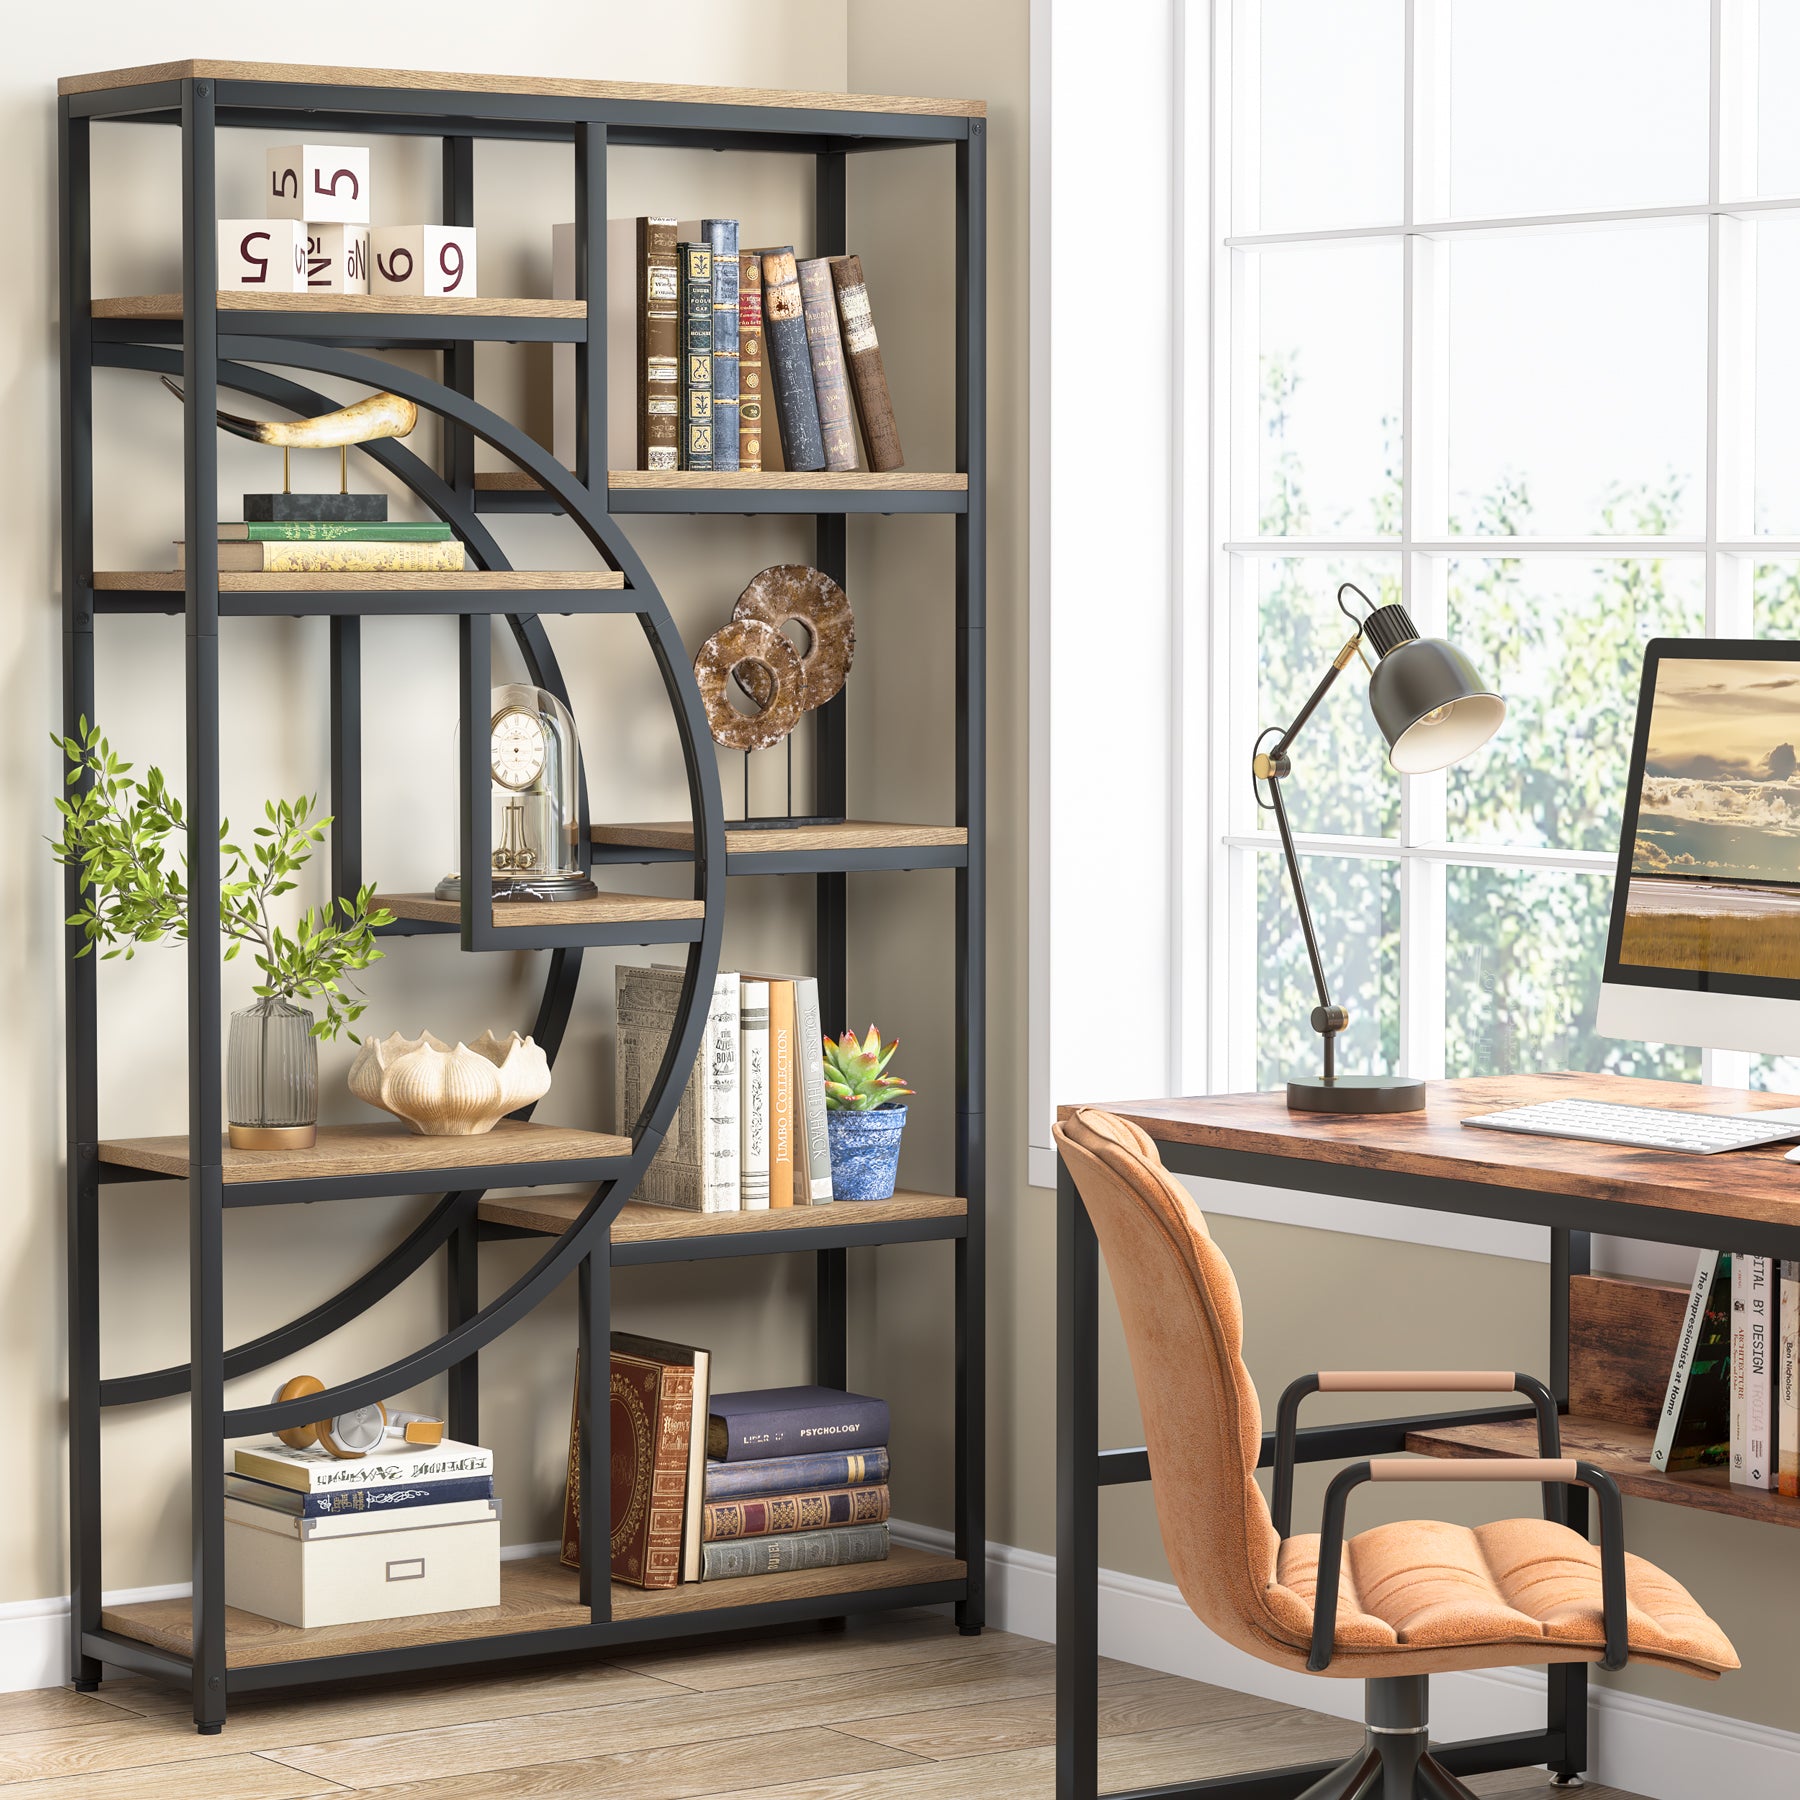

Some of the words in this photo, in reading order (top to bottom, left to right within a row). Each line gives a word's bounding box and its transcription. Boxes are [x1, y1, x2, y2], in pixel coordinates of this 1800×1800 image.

[273, 169, 297, 198] 5
[315, 169, 359, 200] 5
[240, 232, 270, 282] 5
[804, 1005, 818, 1060] YOUNG
[776, 1029, 788, 1113] COLLECTION
[806, 1080, 823, 1106] THE
[776, 1117, 790, 1164] JUMBO
[809, 1111, 828, 1161] SHACK
[1697, 1270, 1709, 1291] The
[1753, 1300, 1764, 1316] BY
[1678, 1291, 1703, 1370] Impressionists
[1753, 1324, 1763, 1375] DESIGN
[1674, 1373, 1682, 1385] at
[1785, 1360, 1793, 1401] Nicholson
[1667, 1385, 1680, 1416] Home
[800, 1423, 860, 1437] PSYCHOLOGY
